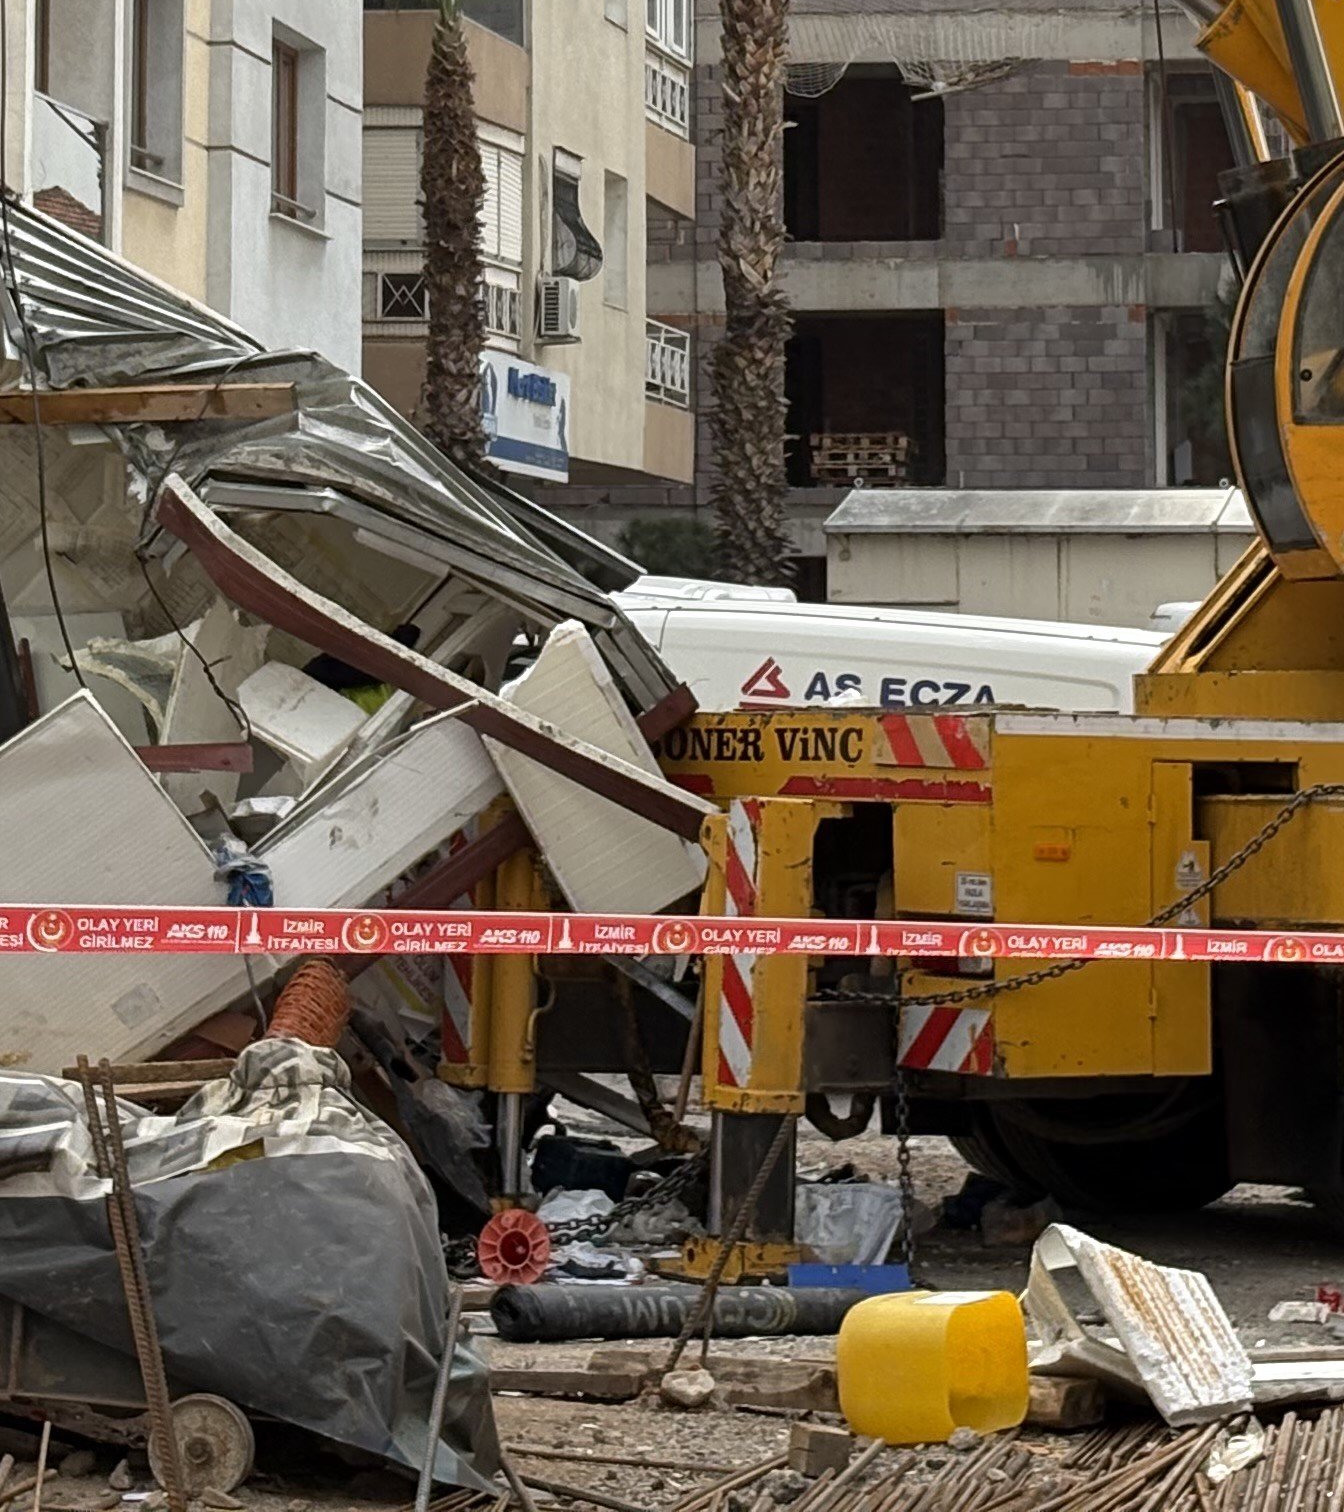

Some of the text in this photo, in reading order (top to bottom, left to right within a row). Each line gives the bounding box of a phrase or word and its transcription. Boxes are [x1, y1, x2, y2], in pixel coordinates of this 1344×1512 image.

[805, 672, 996, 707] AS ECZA
[77, 917, 159, 932] OLAY YERİ
[166, 923, 229, 939] AKS 110
[283, 919, 325, 934] İZMİR
[391, 921, 472, 936] OLAY YERİ
[79, 934, 154, 949] GİRİLMEZ
[267, 935, 339, 950] İTFAİYESİ
[480, 929, 541, 944] AKS 110
[701, 929, 743, 943] OLAY
[1007, 936, 1049, 949] OLAY
[393, 938, 467, 952] GİRİLMEZ
